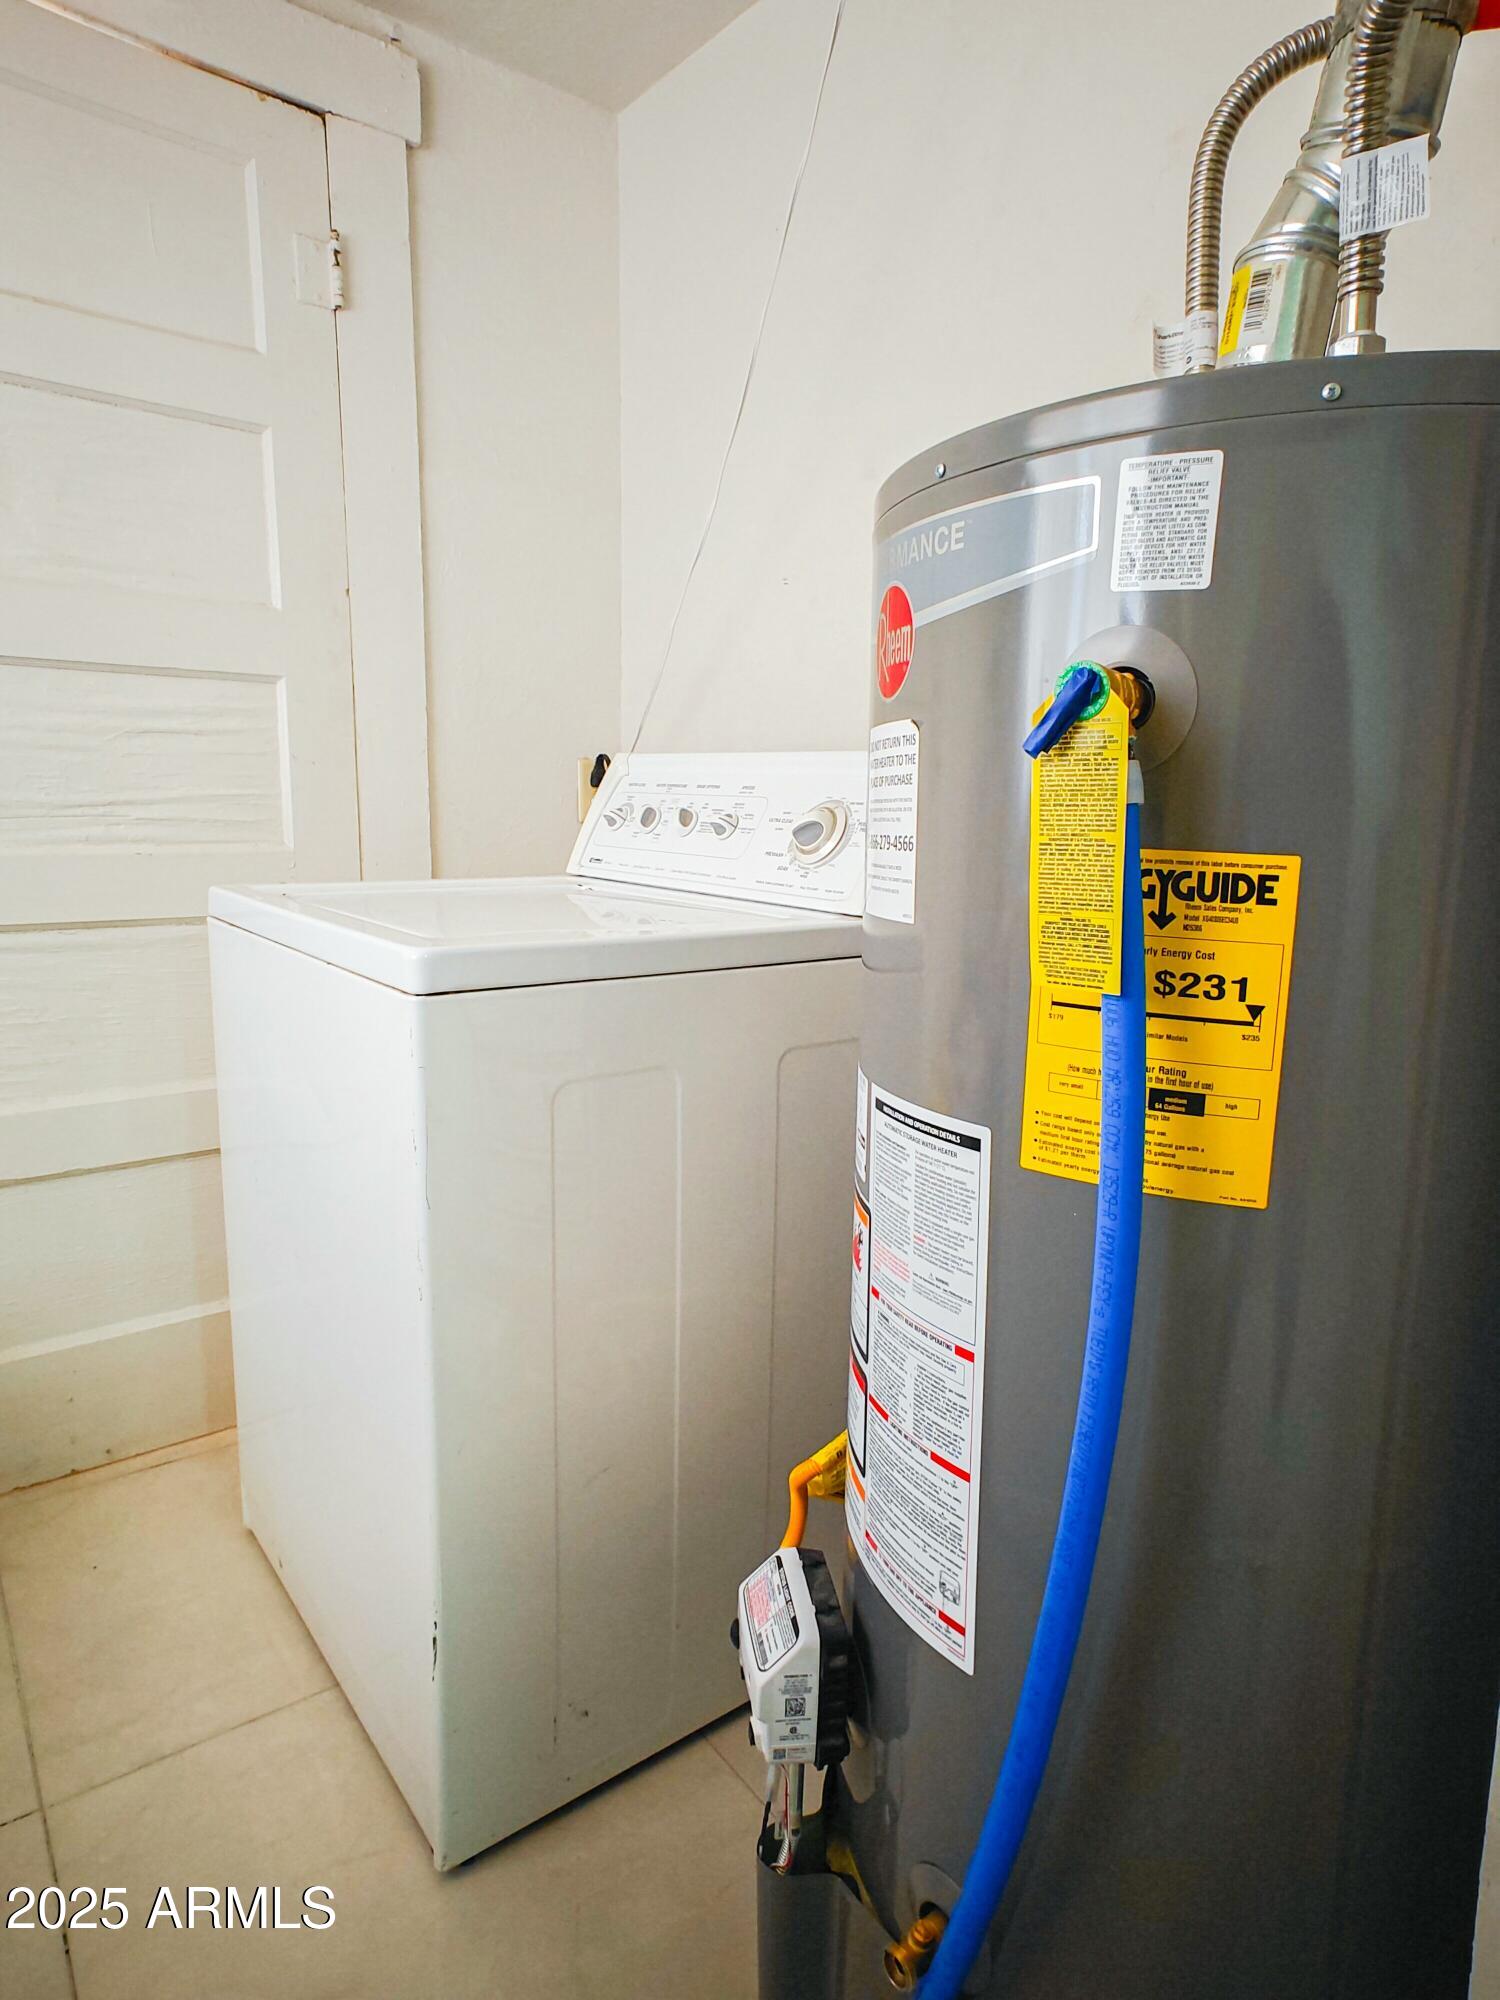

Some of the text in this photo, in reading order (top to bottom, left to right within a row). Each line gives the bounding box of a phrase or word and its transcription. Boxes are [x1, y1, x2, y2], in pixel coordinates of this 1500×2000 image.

[1129, 457, 1214, 471] TEMPERATURE PRESSURE
[1167, 481, 1209, 489] MAINTENANCE
[1130, 490, 1169, 498] PROCEDURES
[1133, 504, 1172, 512] INSTRUCTION
[878, 591, 911, 683] Rheem
[881, 734, 916, 750] RETURN THIS
[879, 755, 895, 768] HEATER
[896, 754, 903, 766] TO
[904, 753, 916, 765] THE
[879, 773, 912, 787] OF PURCHASE
[1141, 868, 1280, 906] GYGUIDE
[1161, 948, 1192, 960] Energy
[1196, 950, 1215, 960] Cost
[1153, 969, 1248, 1003] $231
[1166, 1034, 1188, 1042] Models
[1241, 1034, 1260, 1042] $235
[1159, 1066, 1187, 1078] Rating
[1155, 1076, 1163, 1084] the
[1166, 1077, 1177, 1086] first
[1179, 1078, 1192, 1088] hour
[914, 1121, 939, 1136] OPERATION
[939, 1130, 960, 1143] DETAILS
[921, 1140, 937, 1151] WATER
[938, 1146, 957, 1159] HEATER
[1161, 1162, 1185, 1170] average
[914, 1325, 928, 1338] BEFORE
[929, 1334, 952, 1351] OPERATING
